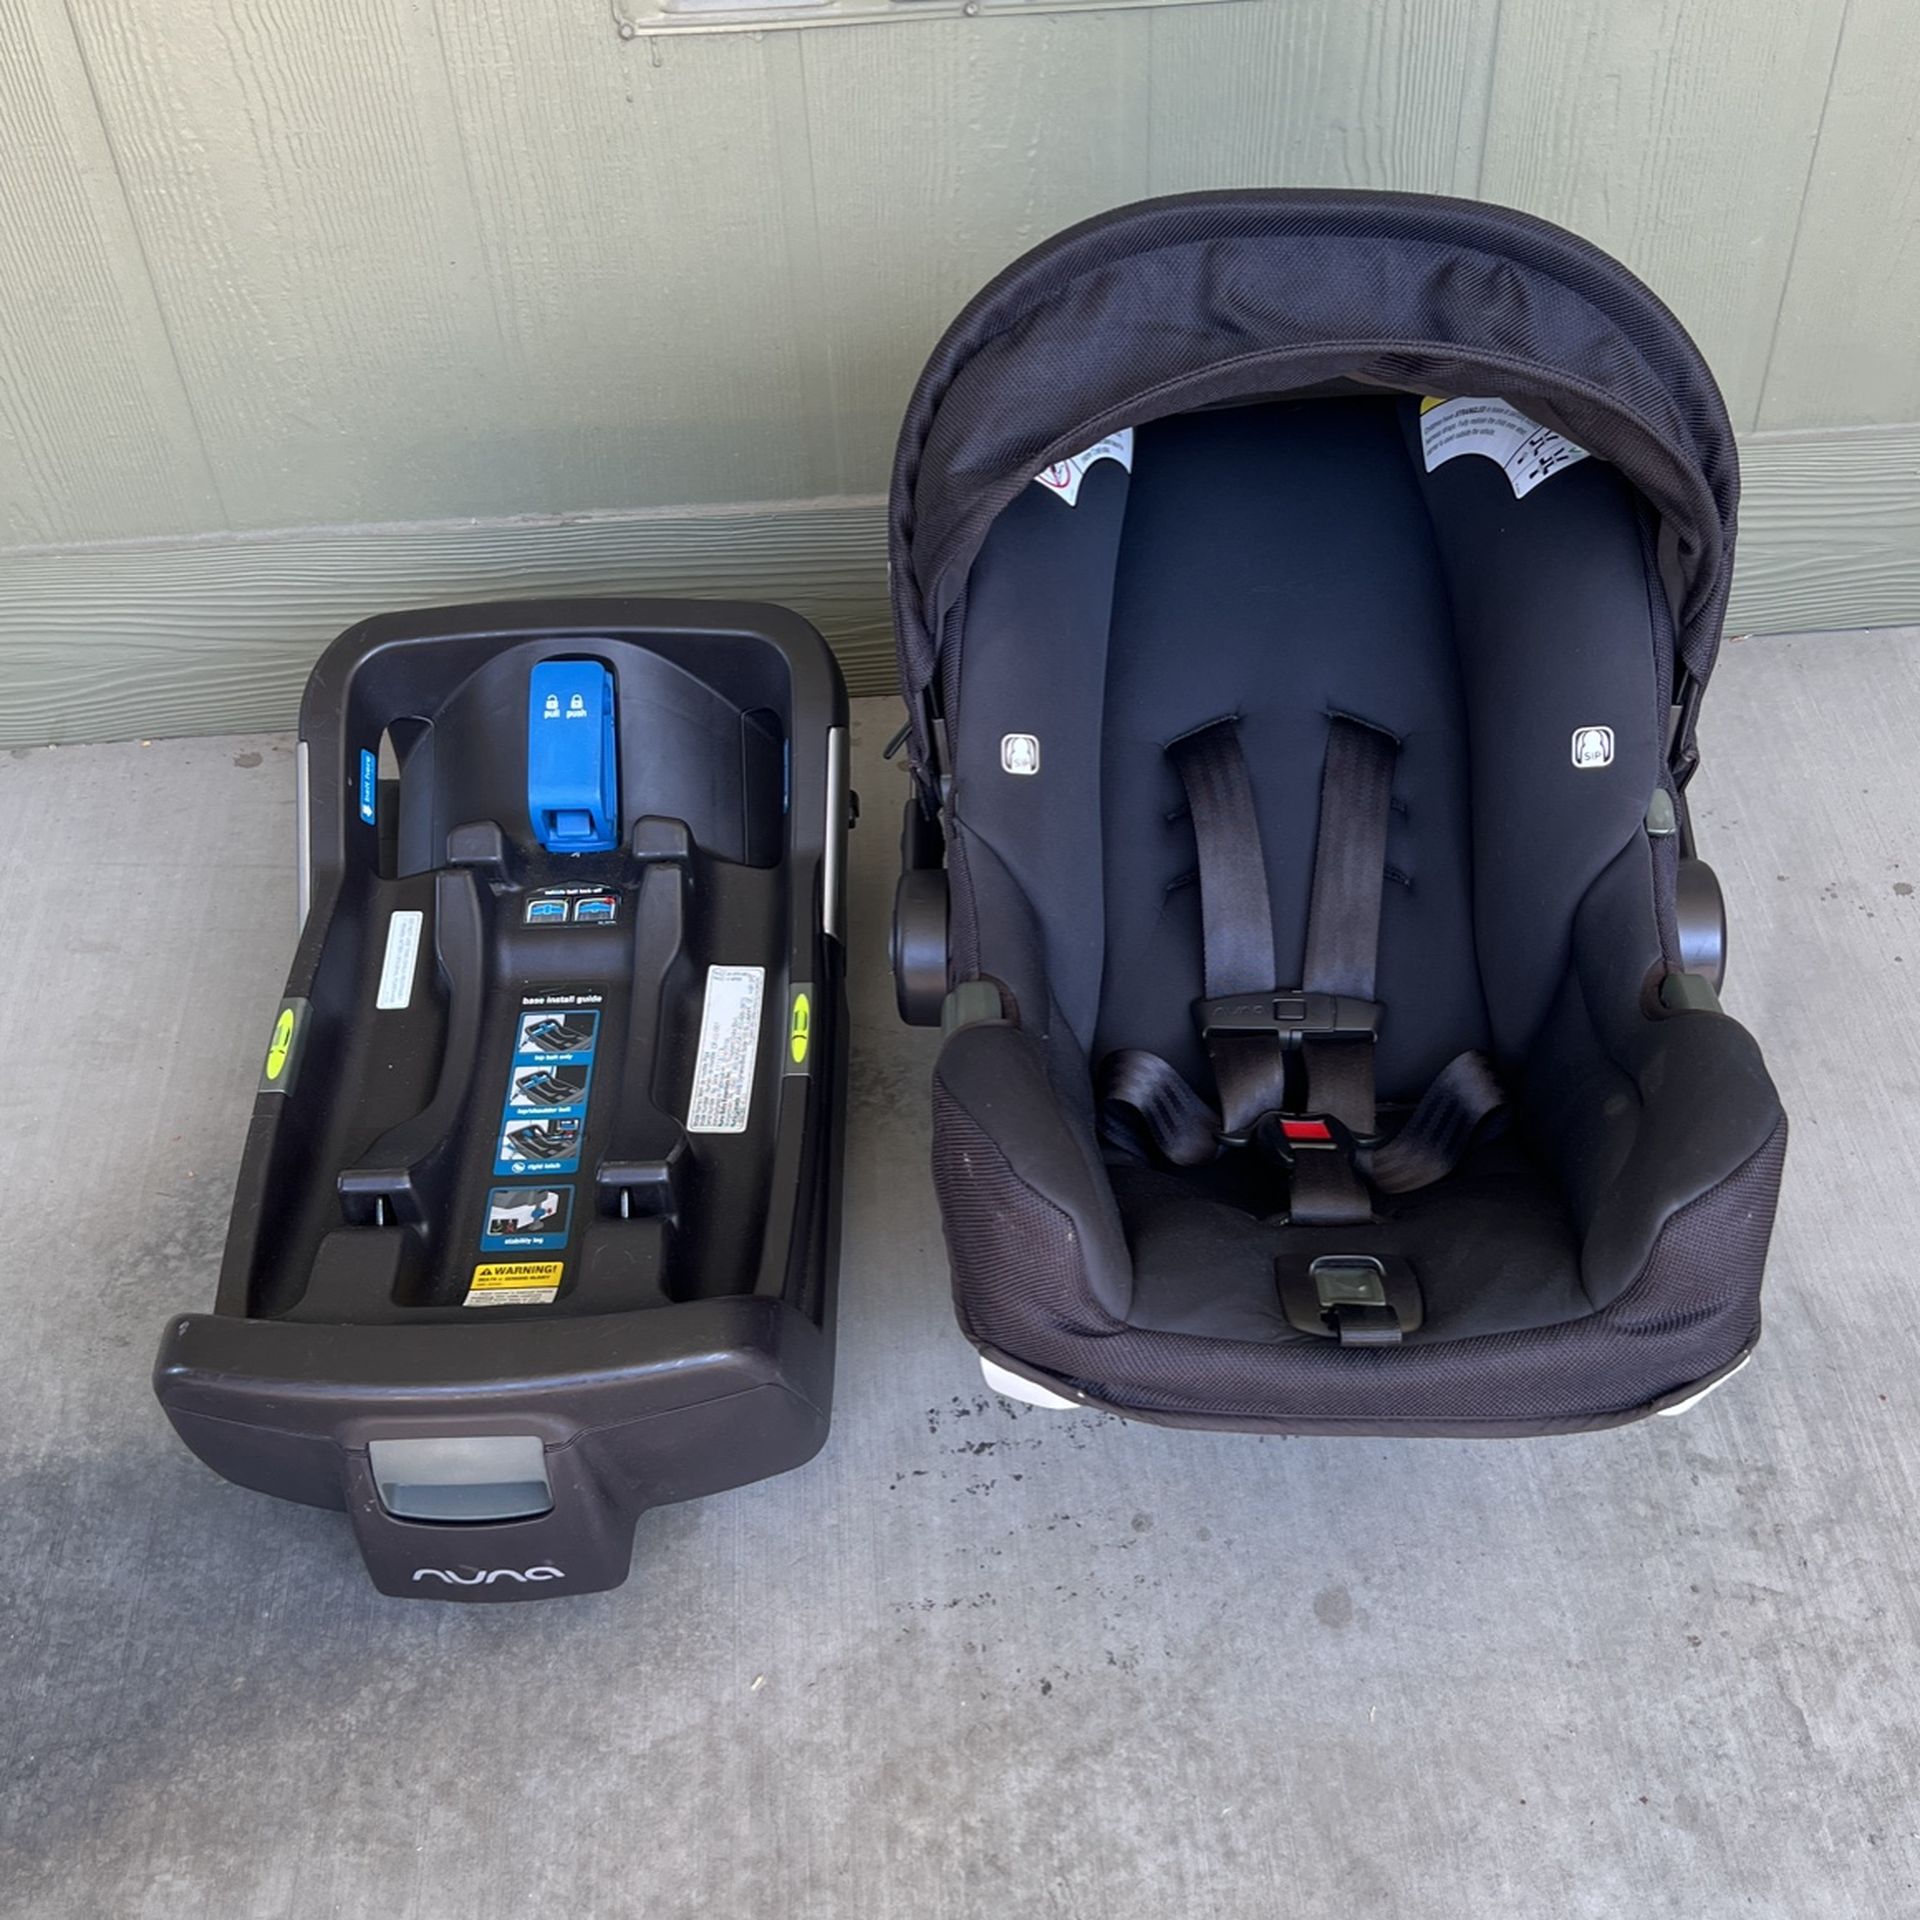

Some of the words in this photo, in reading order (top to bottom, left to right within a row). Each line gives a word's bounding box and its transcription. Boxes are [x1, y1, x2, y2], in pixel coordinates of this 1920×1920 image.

[544, 709, 560, 720] pull
[566, 709, 587, 720] push
[363, 755, 371, 780] here
[522, 996, 545, 1005] base
[546, 994, 575, 1004] install
[576, 994, 603, 1005] guide
[494, 1264, 559, 1276] WARNING!
[412, 1566, 566, 1585] nuna
